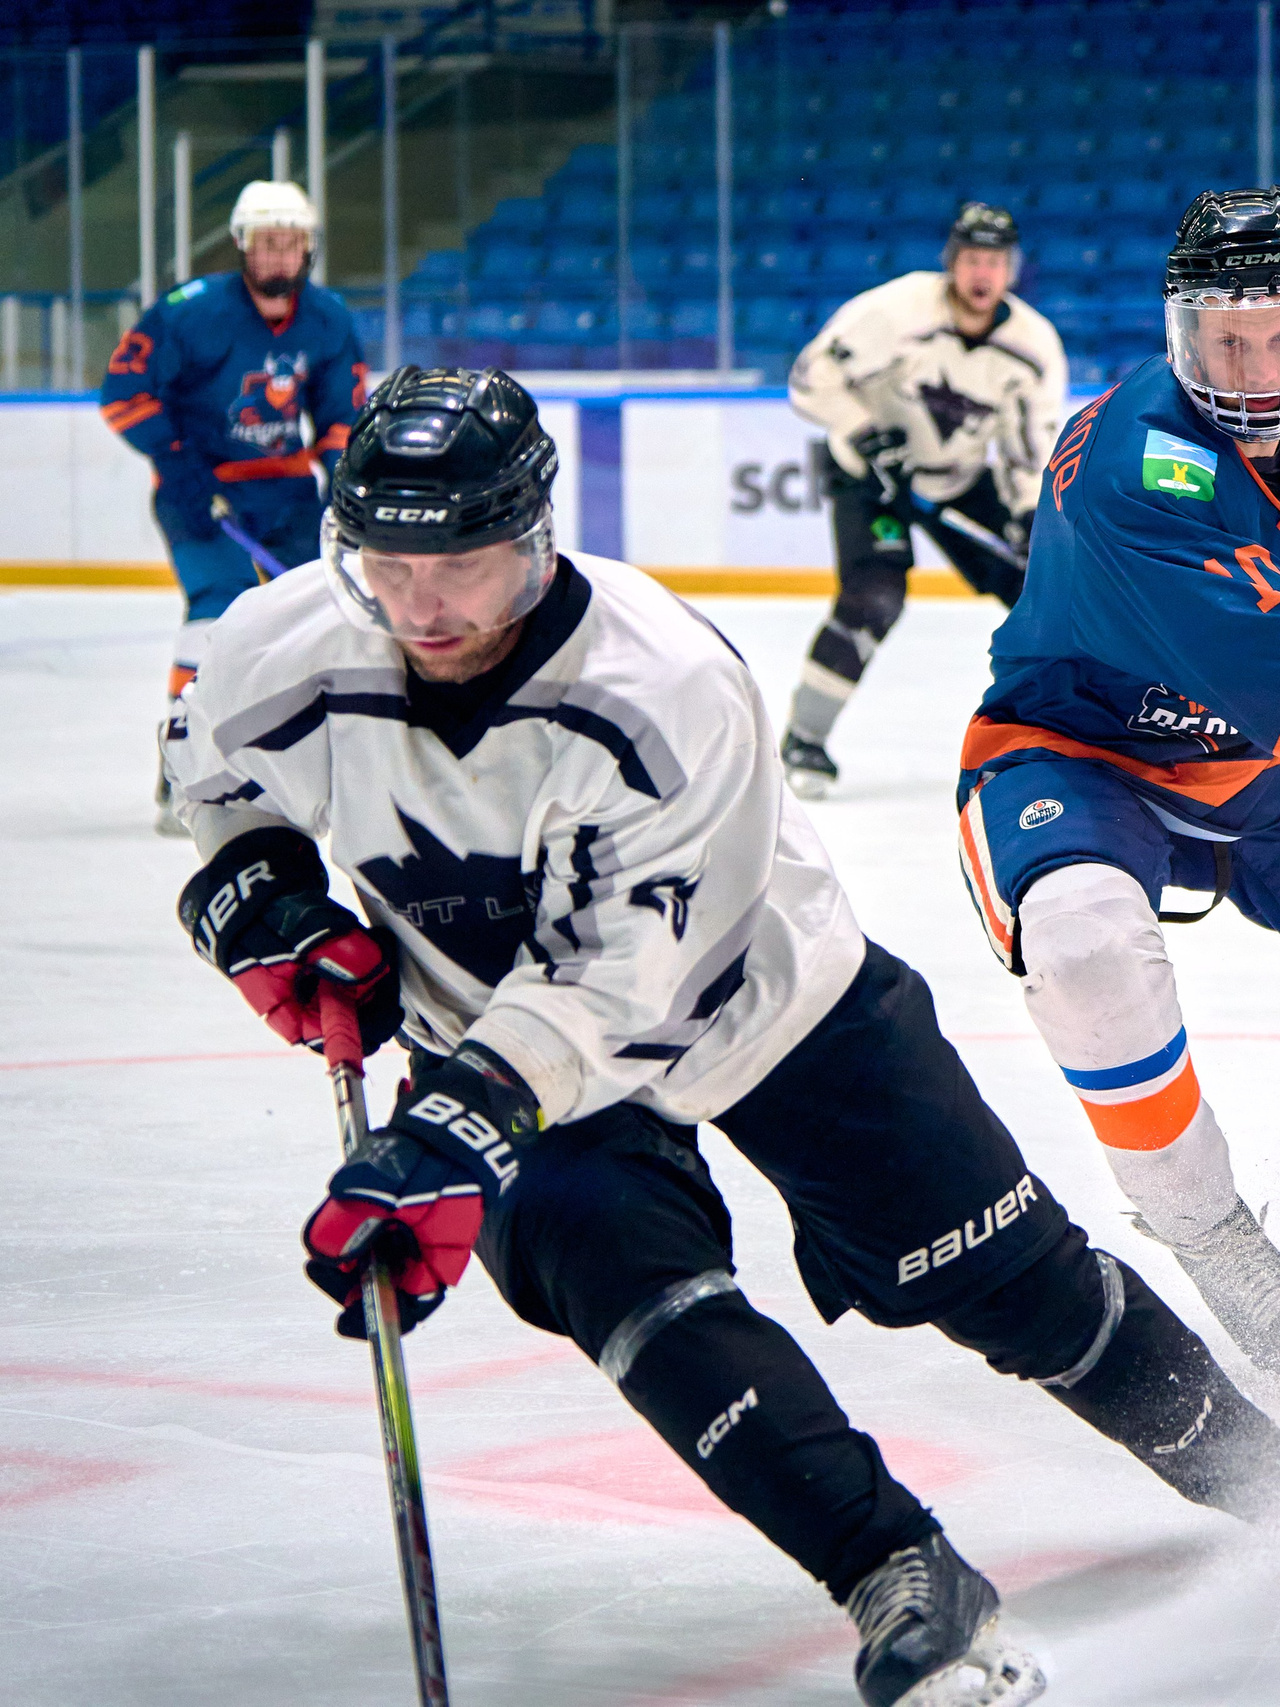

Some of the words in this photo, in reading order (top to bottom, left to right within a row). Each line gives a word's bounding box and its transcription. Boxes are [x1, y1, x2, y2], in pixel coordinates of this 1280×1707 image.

[375, 506, 448, 523] CCM
[1025, 806, 1057, 826] OILERS
[897, 1174, 1038, 1286] BAUER
[697, 1387, 759, 1459] CCM
[1153, 1395, 1213, 1454] CCM
